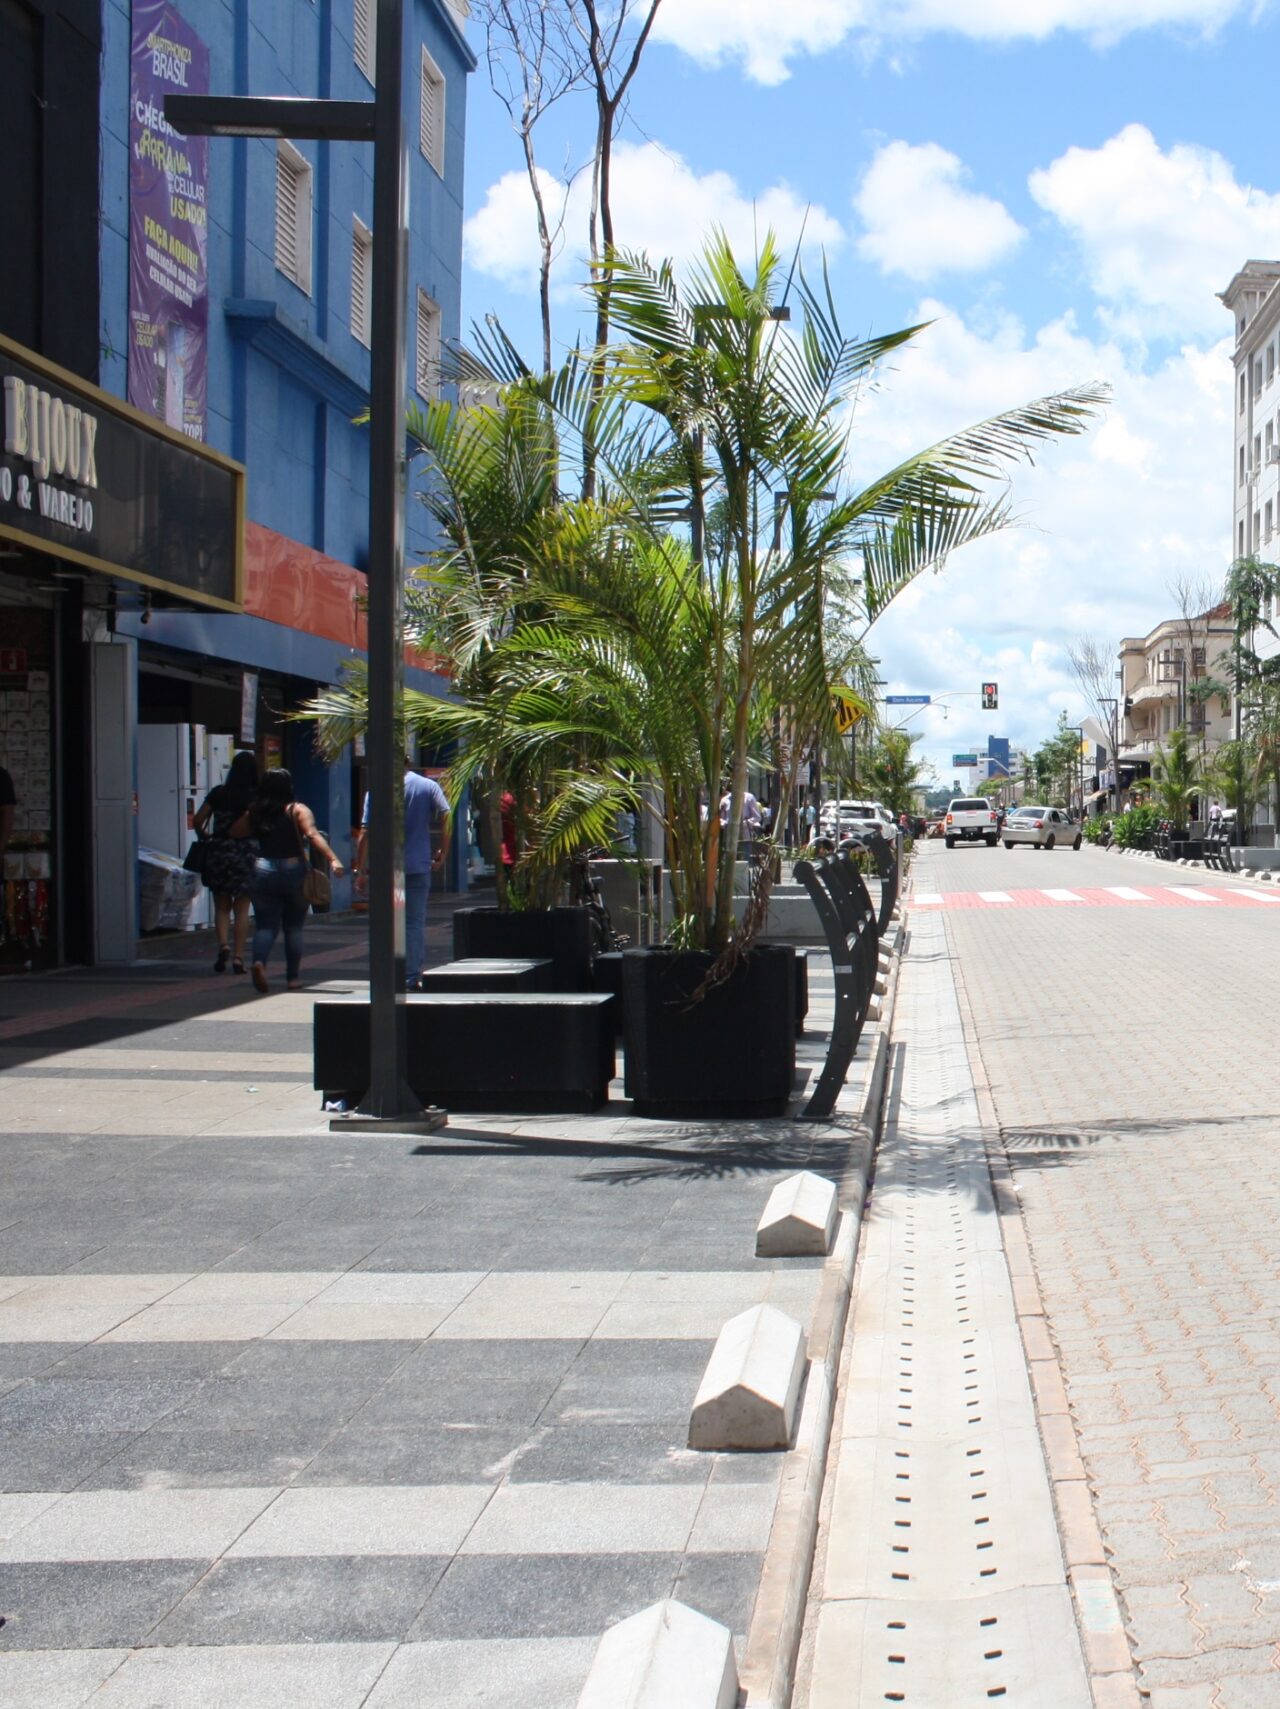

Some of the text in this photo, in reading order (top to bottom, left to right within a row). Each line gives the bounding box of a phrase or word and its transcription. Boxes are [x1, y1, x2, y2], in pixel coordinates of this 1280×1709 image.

[152, 50, 188, 87] BRASIL
[174, 175, 205, 203] CELULAR
[4, 376, 98, 488] BIJOUX
[17, 474, 32, 510] &
[38, 482, 93, 532] VAREJO
